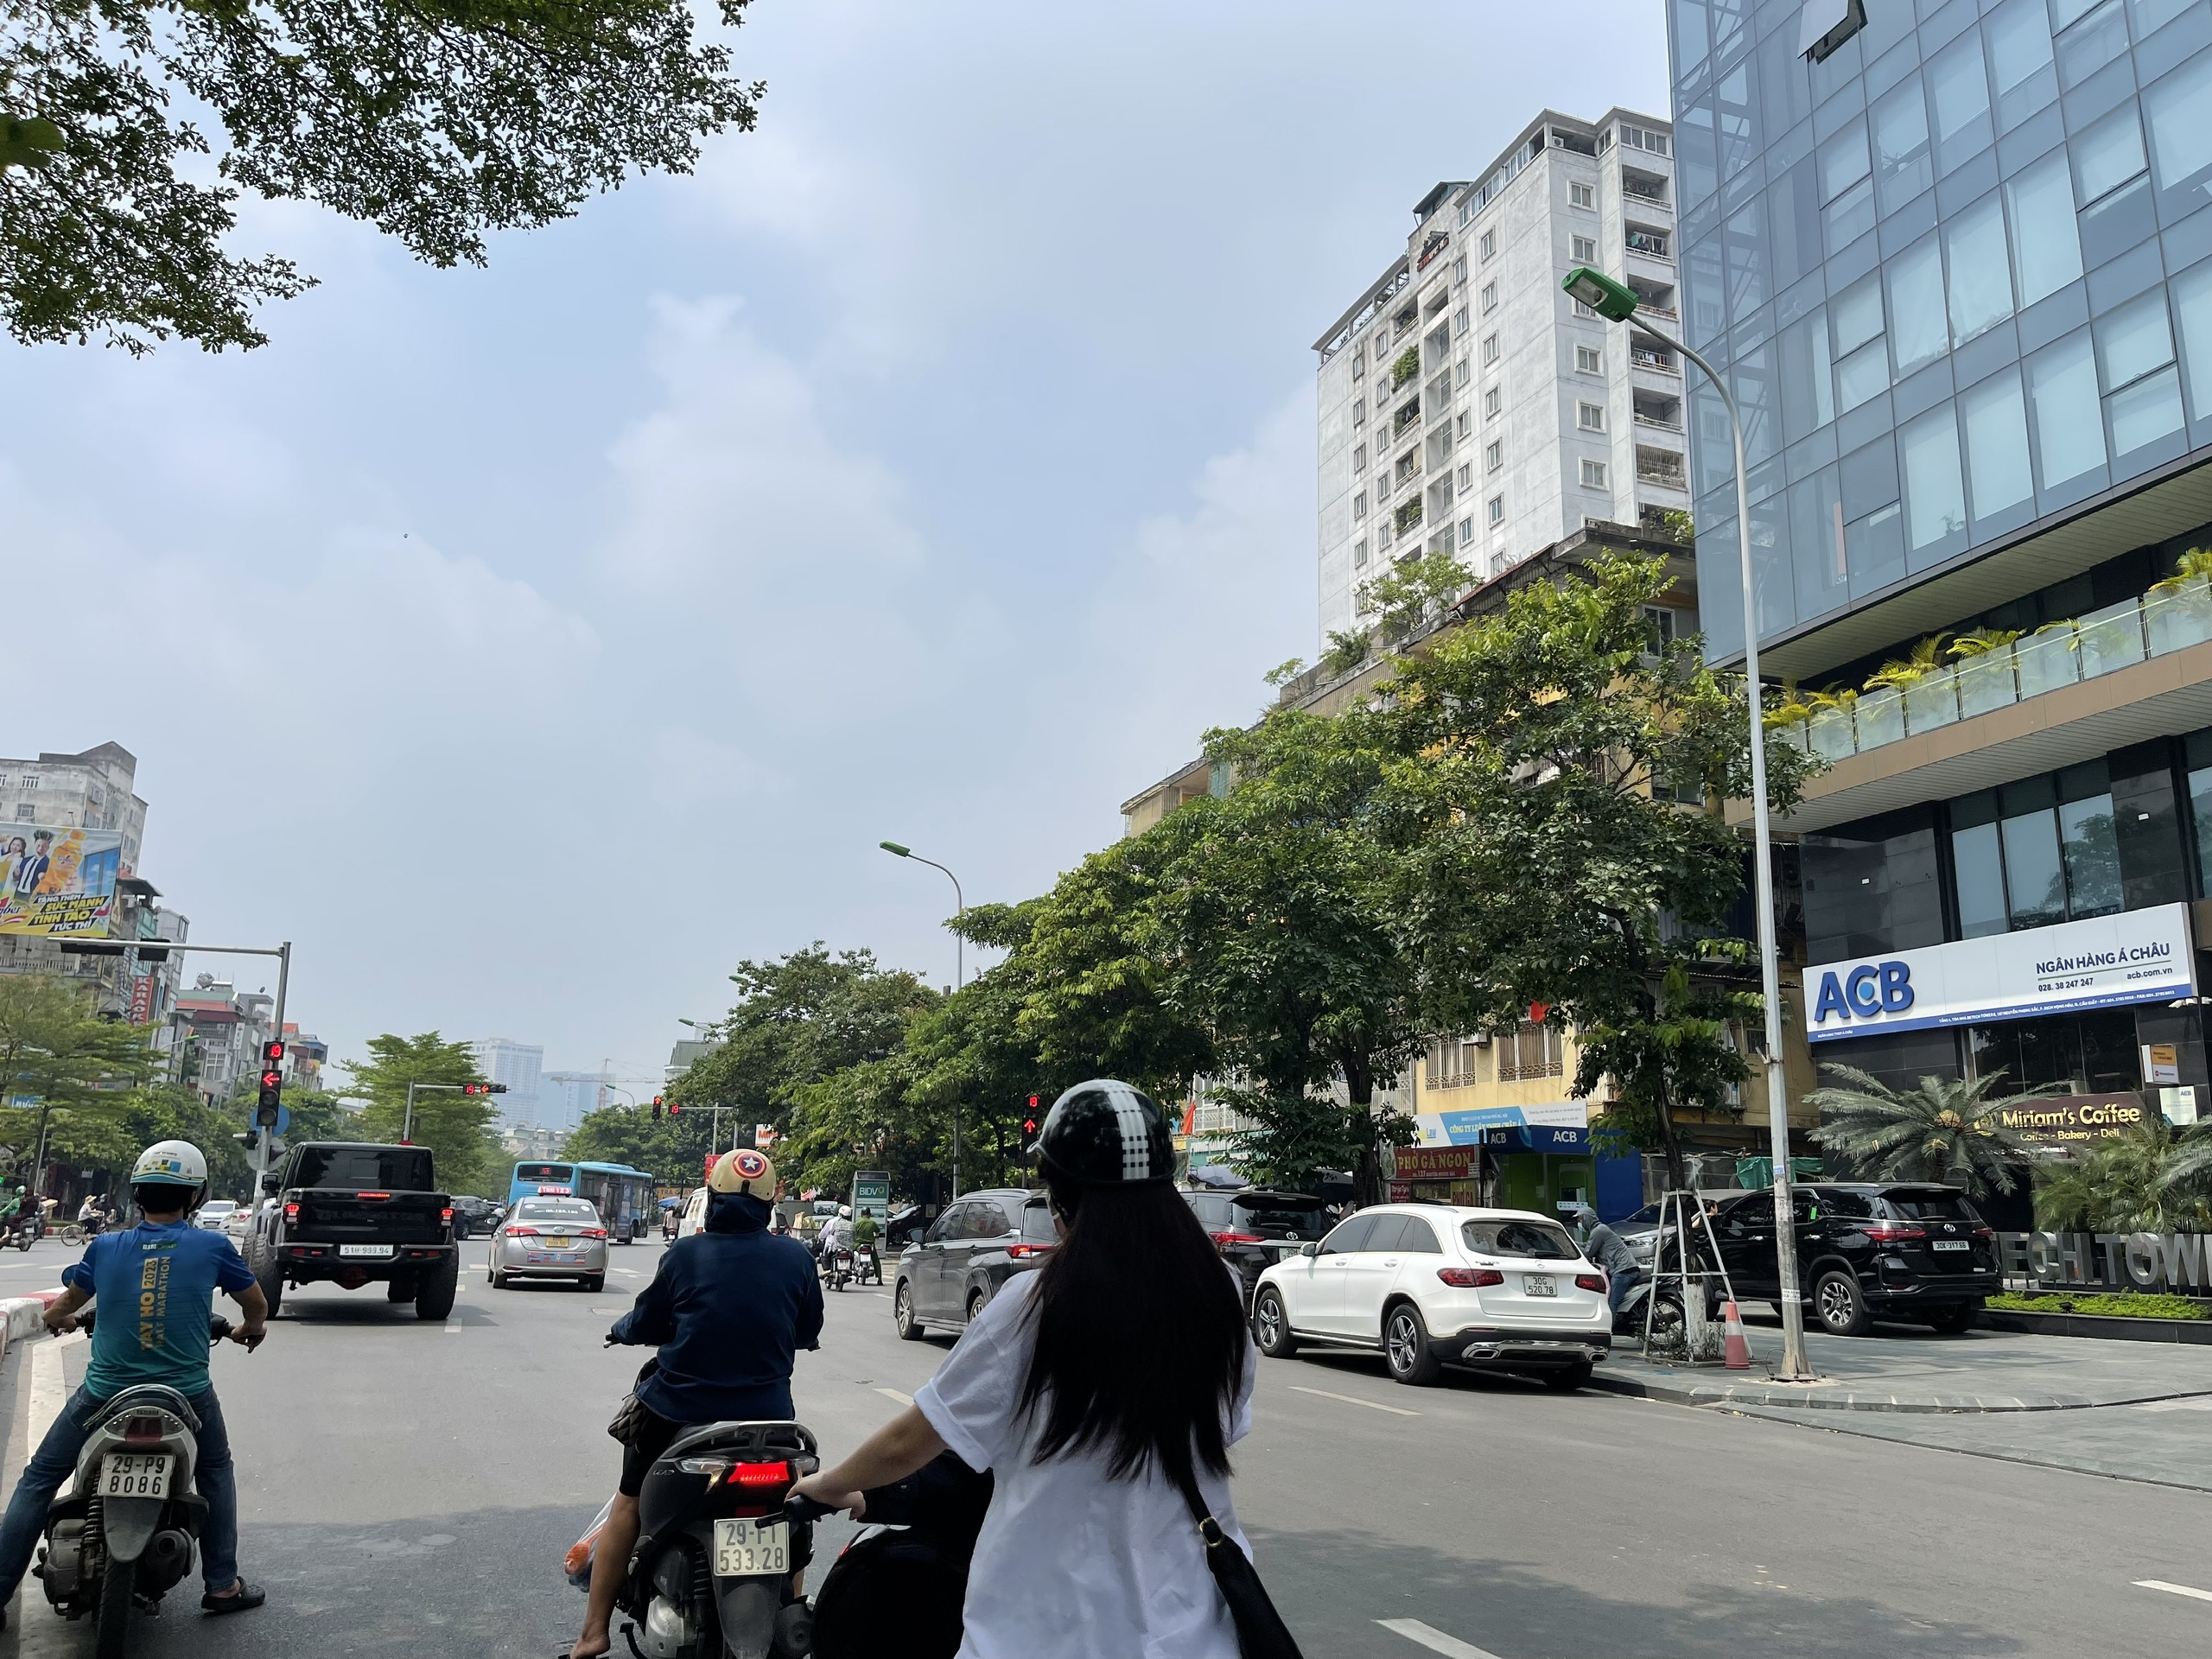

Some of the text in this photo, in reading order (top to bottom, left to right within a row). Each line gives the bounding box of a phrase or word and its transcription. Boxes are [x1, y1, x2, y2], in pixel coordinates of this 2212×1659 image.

[69, 897, 105, 911] MẠNH
[2036, 942, 2171, 974] NGÂN HÀNG Á CHÂU
[2126, 967, 2173, 980] acb.com.vn
[1815, 961, 1915, 1022] ACB
[2037, 977, 2094, 992] 028. 38 247 247
[467, 1085, 474, 1095] 19
[1029, 1096, 1038, 1107] 19
[2002, 1103, 2141, 1128] Miriam's Coffee
[1491, 1133, 1506, 1145] ACB
[1553, 1130, 1577, 1143] ACB
[2057, 1130, 2091, 1141] Bakery
[2101, 1128, 2120, 1138] Deli
[1397, 1150, 1471, 1170] PHỞ GÀ NGON
[859, 1186, 879, 1196] BIDV
[1991, 1231, 2212, 1286] ECH TOW
[144, 1260, 157, 1286] 2023
[157, 1255, 171, 1317] MARATHON
[1532, 1276, 1548, 1286] 30G
[1528, 1285, 1554, 1295] 520.78
[111, 1455, 166, 1474] 29-P9
[109, 1475, 162, 1495] 8086
[720, 1547, 784, 1572] 533.28
